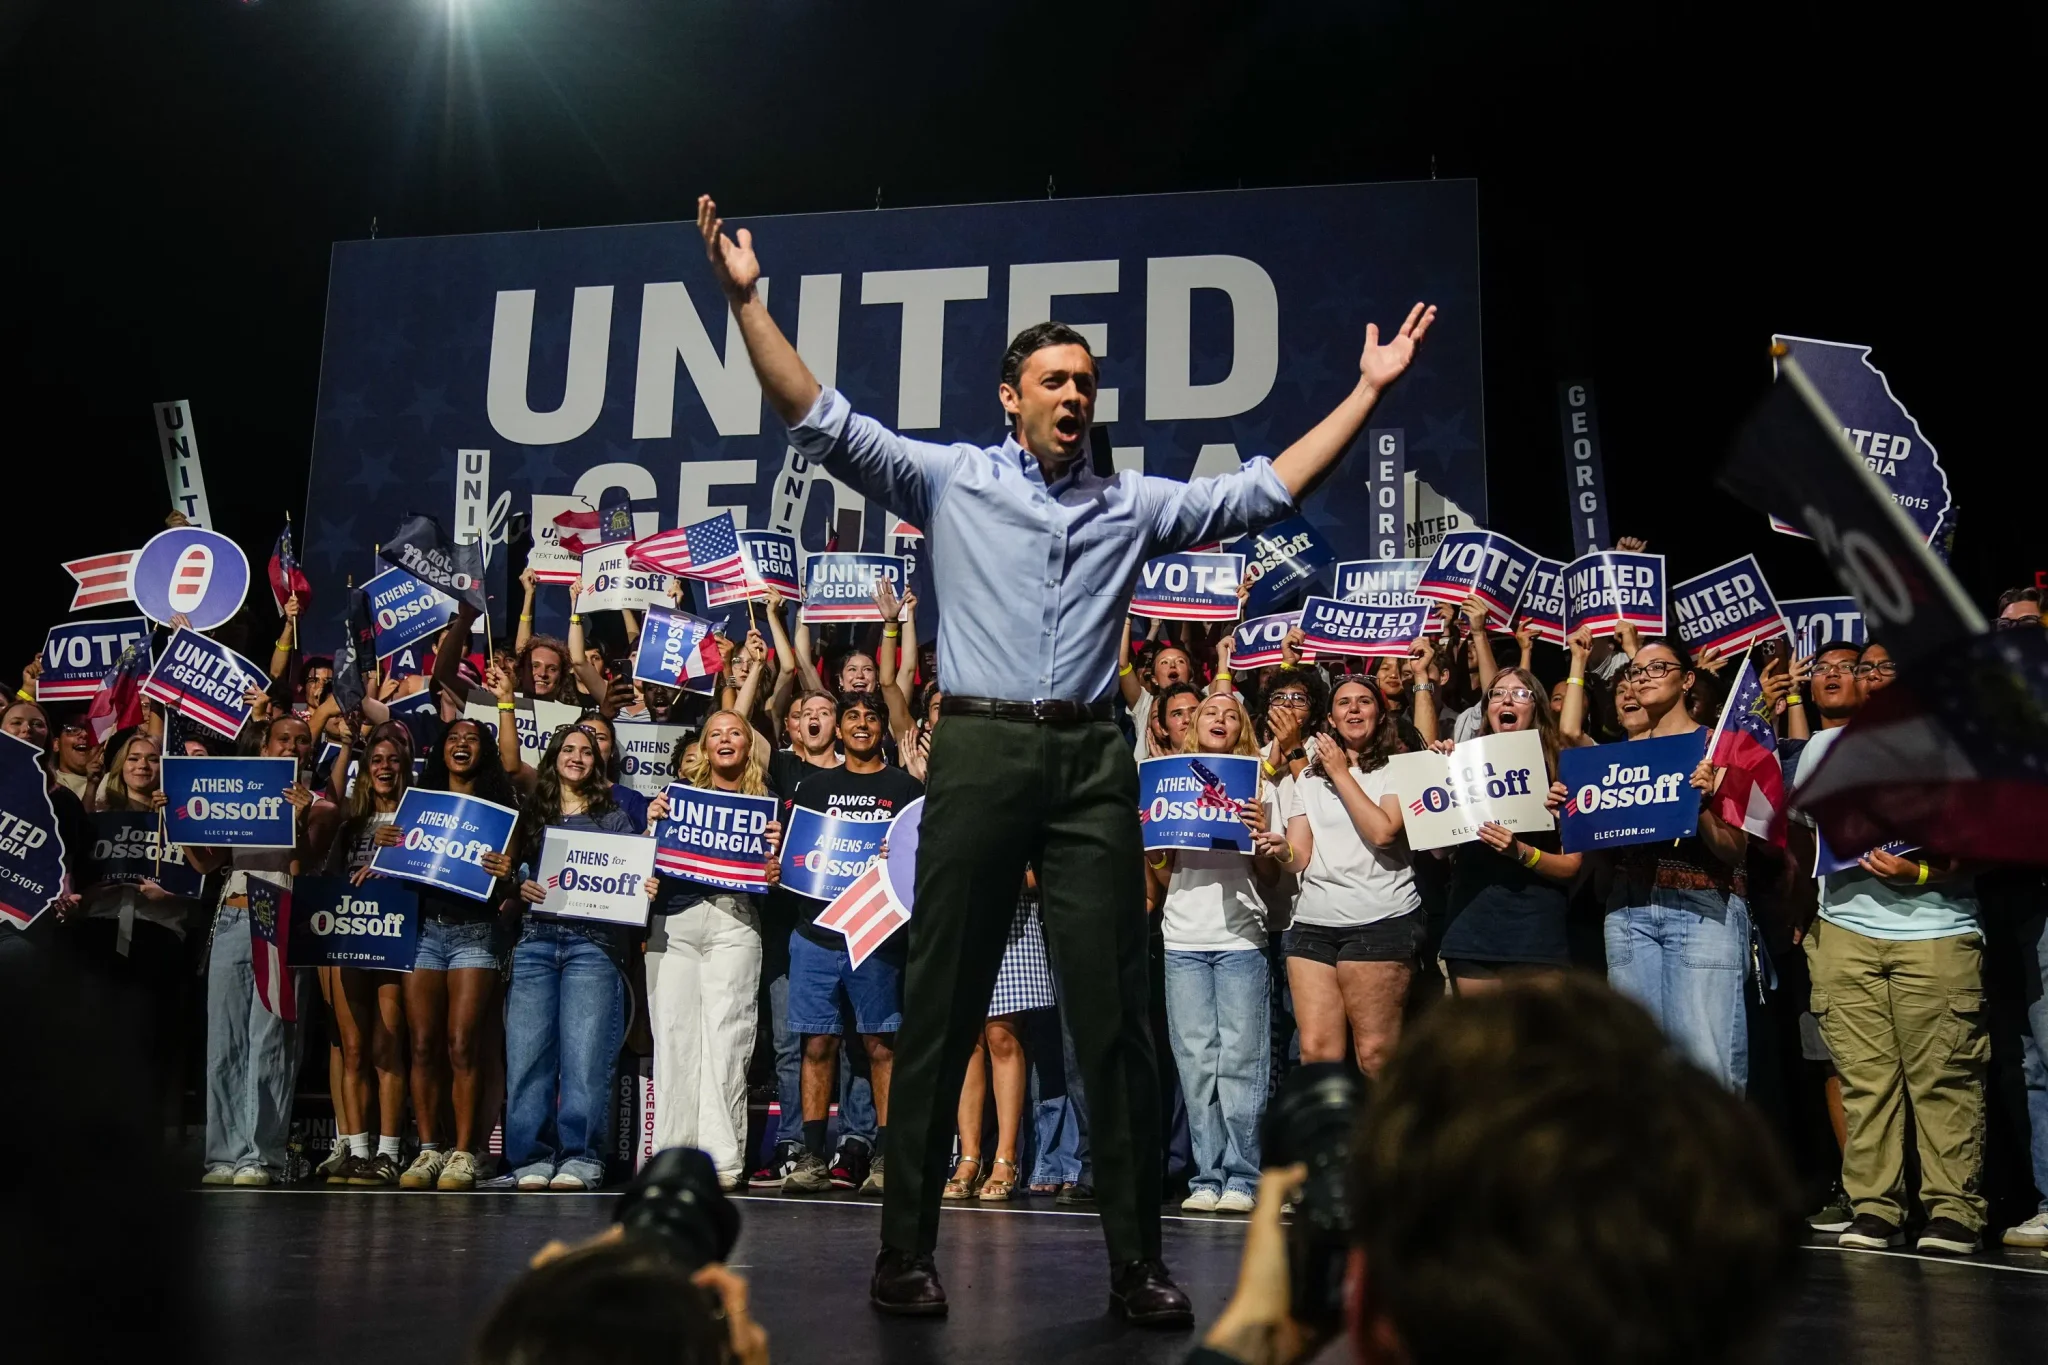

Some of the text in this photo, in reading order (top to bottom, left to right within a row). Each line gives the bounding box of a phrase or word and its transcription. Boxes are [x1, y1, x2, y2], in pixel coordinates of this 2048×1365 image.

[487, 254, 1280, 446] UNITED
[162, 406, 202, 529] UNIT
[776, 452, 809, 534] UNI
[1891, 493, 1930, 510] 51015
[1253, 532, 1288, 559] Jon
[1408, 533, 1446, 549] GEORG
[535, 552, 552, 560] TEXT
[599, 558, 626, 572] ATHE
[1245, 532, 1314, 582] Ossoff
[812, 563, 899, 584] UNITED
[1142, 561, 1236, 596] VOTE
[1437, 542, 1526, 595] VOTE
[594, 573, 667, 592] Ossoff
[823, 583, 899, 599] GEOR
[1459, 577, 1474, 585] VOTE
[1568, 564, 1655, 600] UNITED
[374, 580, 415, 609] ATHENS
[1575, 588, 1655, 615] GEORGIA
[1315, 605, 1418, 627] UNITED
[1678, 597, 1766, 642] GEORGIA
[1311, 620, 1413, 639] for GEORGIA
[1783, 611, 1870, 648] VOT
[660, 614, 691, 677] Ossoff
[172, 664, 245, 712] GEORGIA
[625, 740, 670, 754] ATHENS
[191, 778, 265, 794] ATHENS for
[1156, 776, 1205, 794] ATHENS
[1602, 763, 1651, 787] Jon
[827, 794, 893, 808] DAWGS FOR
[1576, 772, 1684, 815] Ossoff
[186, 796, 283, 821] Ossoff
[668, 797, 768, 835] UNITED
[0, 809, 48, 849] TED
[204, 829, 254, 837] ELECTJON.COM
[417, 810, 479, 833] ATHENS for
[114, 825, 159, 843] Jon
[664, 824, 763, 855] for GEORGIA
[814, 834, 875, 853] ATHENS for
[1159, 831, 1210, 839] ELECTJON.COM
[1594, 827, 1656, 841] ELECTJON.COM
[0, 835, 28, 860] GIA
[92, 838, 186, 866] Ossoff
[404, 827, 493, 867] Ossoff
[566, 849, 627, 867] ATHENS for
[804, 849, 881, 878] Ossof
[10, 873, 44, 894] 51015
[558, 866, 642, 897] Ossoff
[335, 895, 379, 916] Jon
[568, 900, 609, 910] ELECTJON.COM
[310, 910, 405, 938] Ossoff
[326, 952, 385, 961] ELECTJON.COM
[619, 1074, 632, 1161] GOVERNOR
